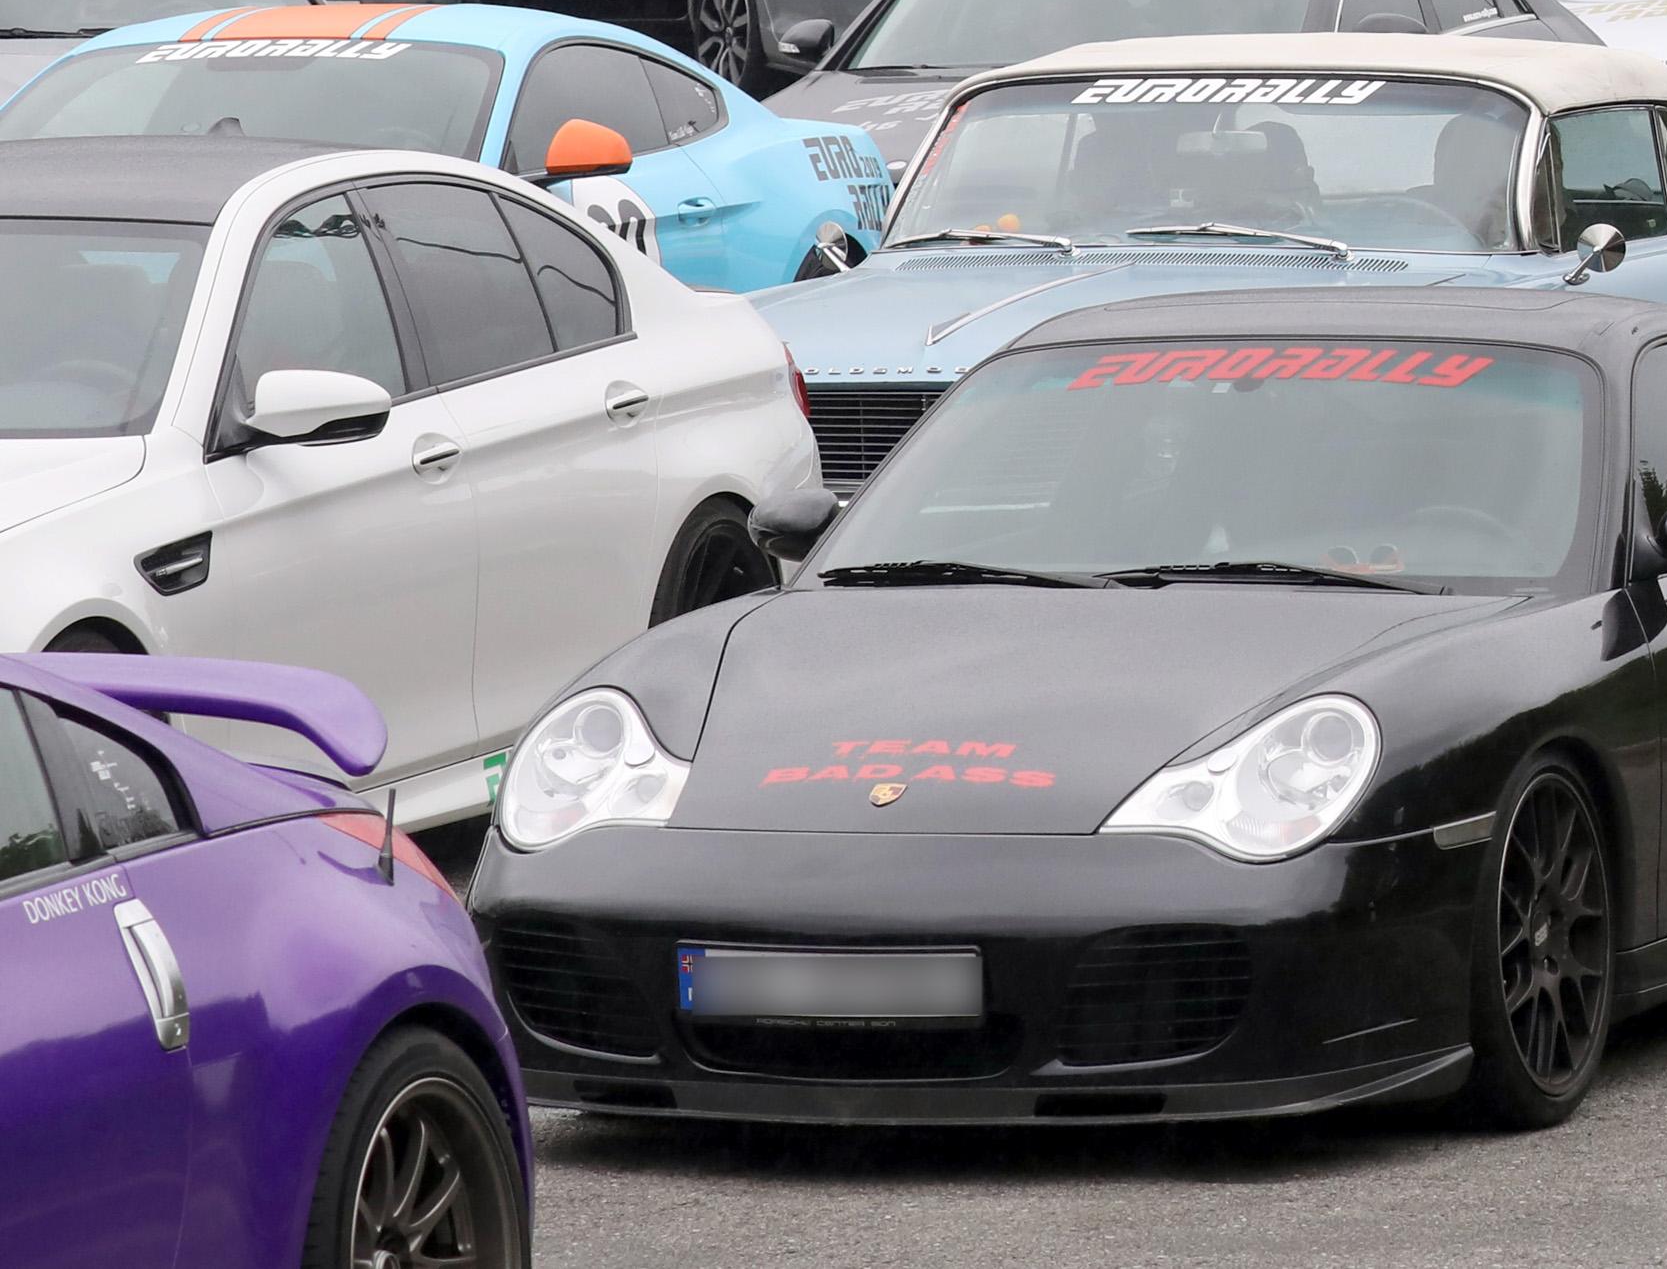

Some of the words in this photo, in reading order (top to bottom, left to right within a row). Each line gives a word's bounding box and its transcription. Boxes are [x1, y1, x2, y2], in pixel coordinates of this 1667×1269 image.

[135, 40, 413, 65] EURORALLY
[1070, 78, 1390, 105] EURORALLY
[803, 135, 860, 181] EURO
[1067, 346, 1494, 392] EURORALLY
[831, 738, 1018, 759] TEAM
[759, 763, 904, 786] BAD
[910, 764, 1057, 789] ASS
[22, 885, 84, 924] DONKEY
[82, 873, 127, 907] KONG
